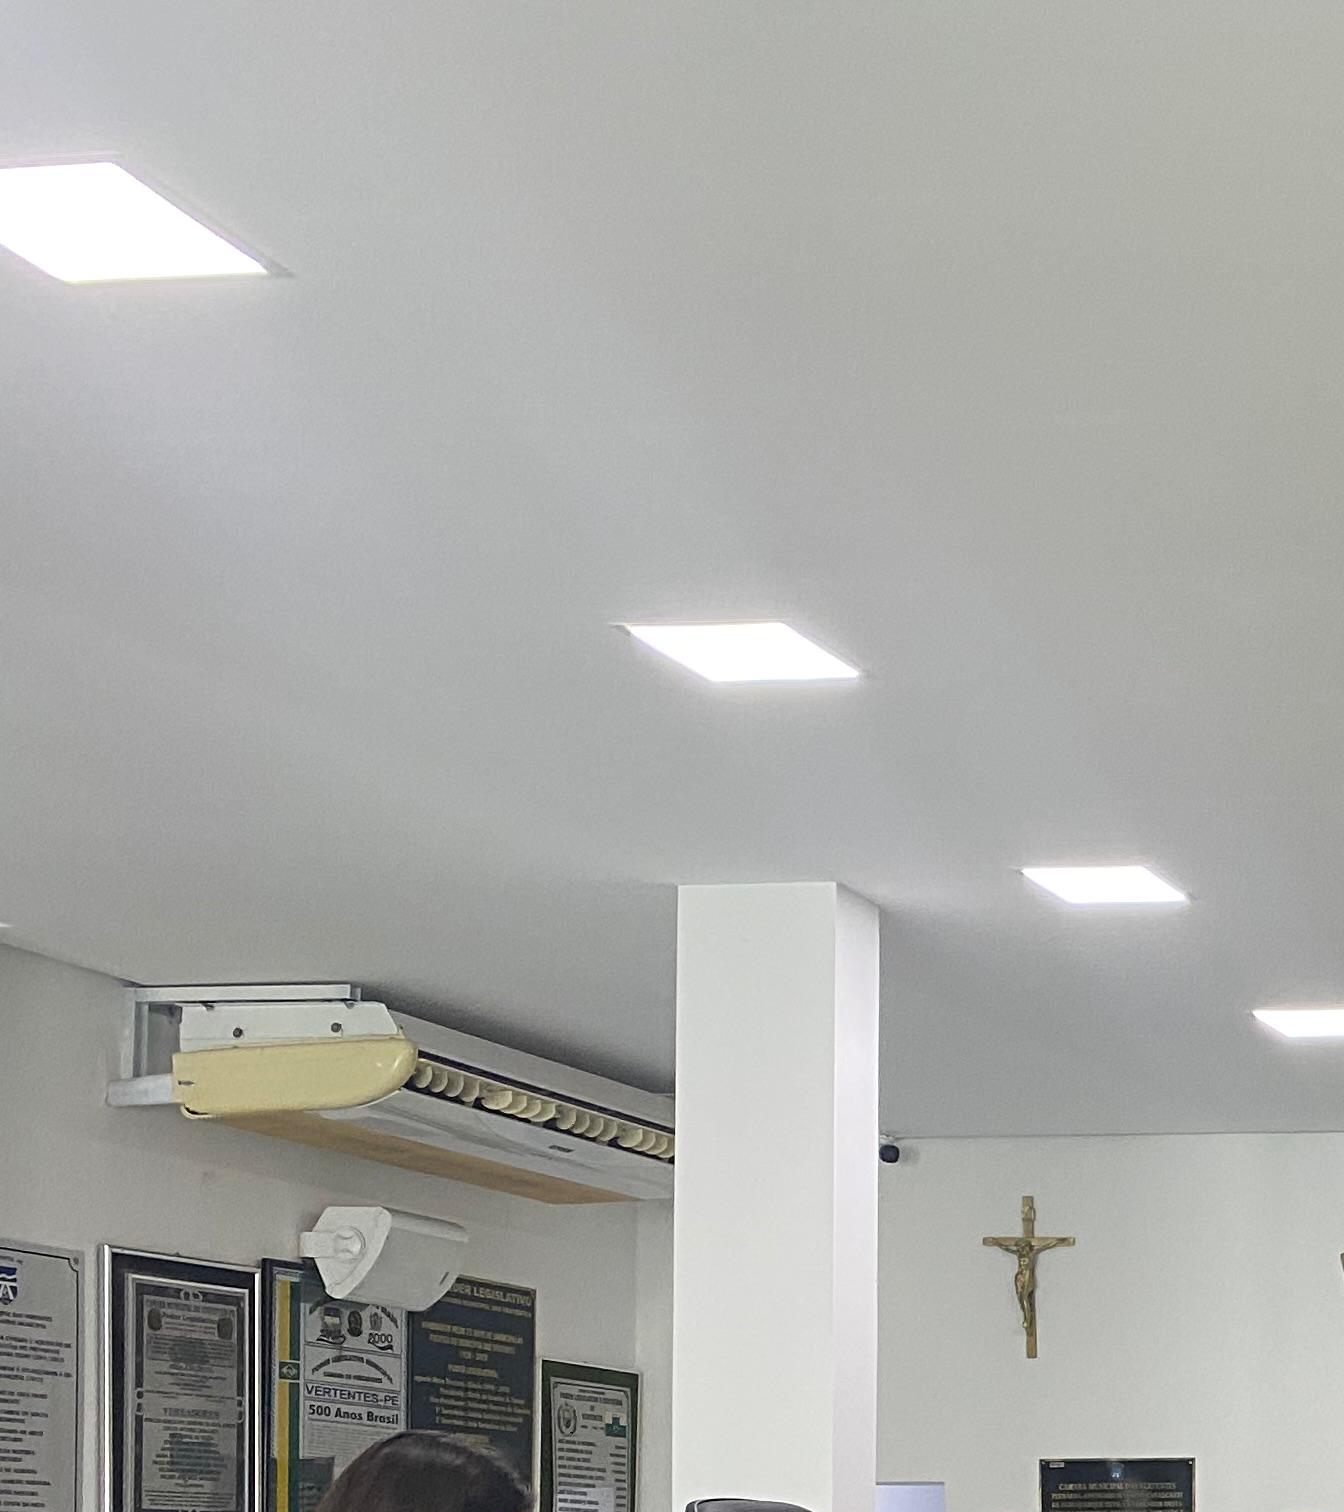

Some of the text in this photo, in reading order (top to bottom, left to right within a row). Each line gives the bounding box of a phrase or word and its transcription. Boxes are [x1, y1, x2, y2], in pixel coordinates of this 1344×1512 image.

[473, 1286, 532, 1305] LEGISLATIVO
[368, 1332, 393, 1344] 2000
[308, 1404, 399, 1425] 500 Anos Brasil
